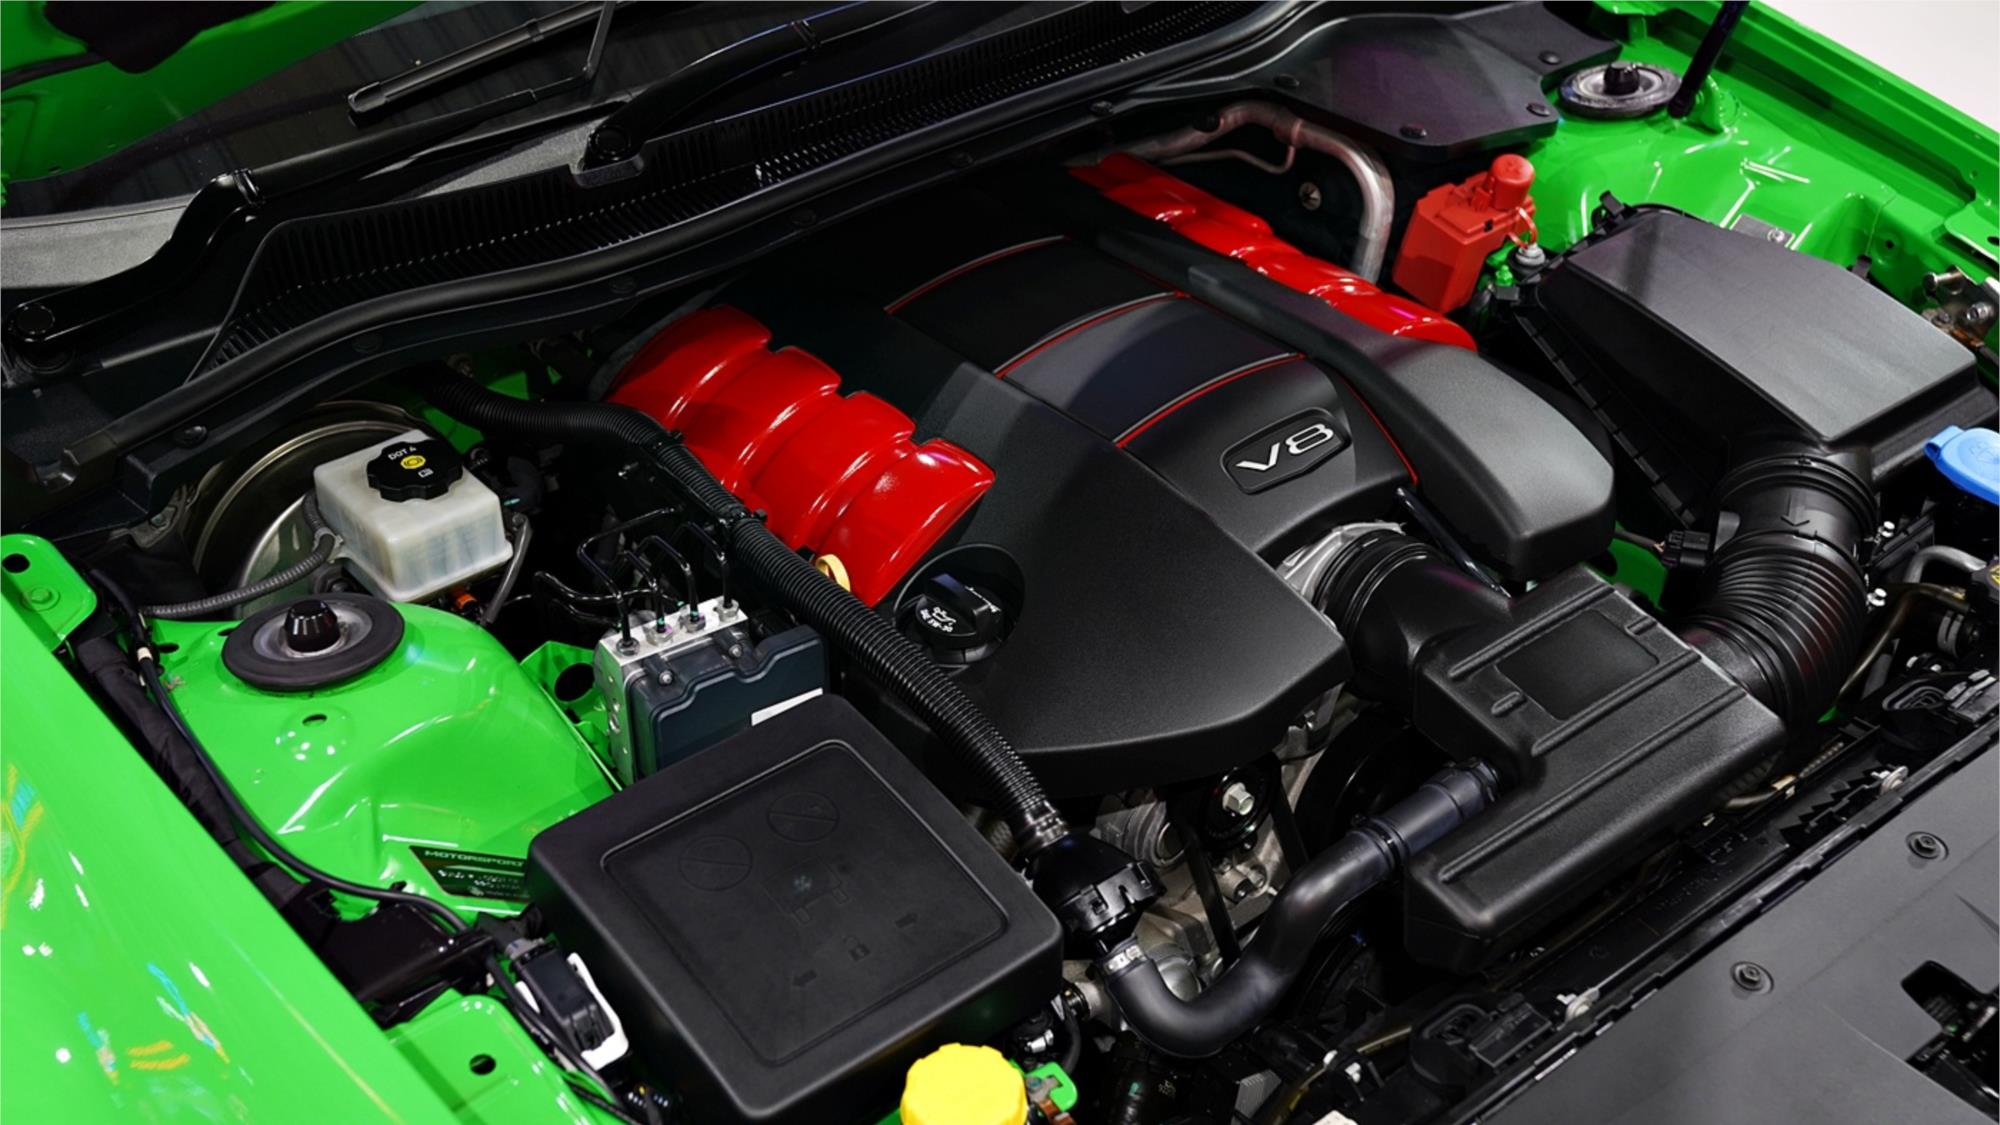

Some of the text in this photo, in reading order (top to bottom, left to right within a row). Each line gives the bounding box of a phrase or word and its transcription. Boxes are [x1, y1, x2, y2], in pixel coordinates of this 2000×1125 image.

[388, 448, 408, 460] DOT
[1235, 423, 1334, 471] V8
[424, 850, 524, 867] MOTORSPORT
